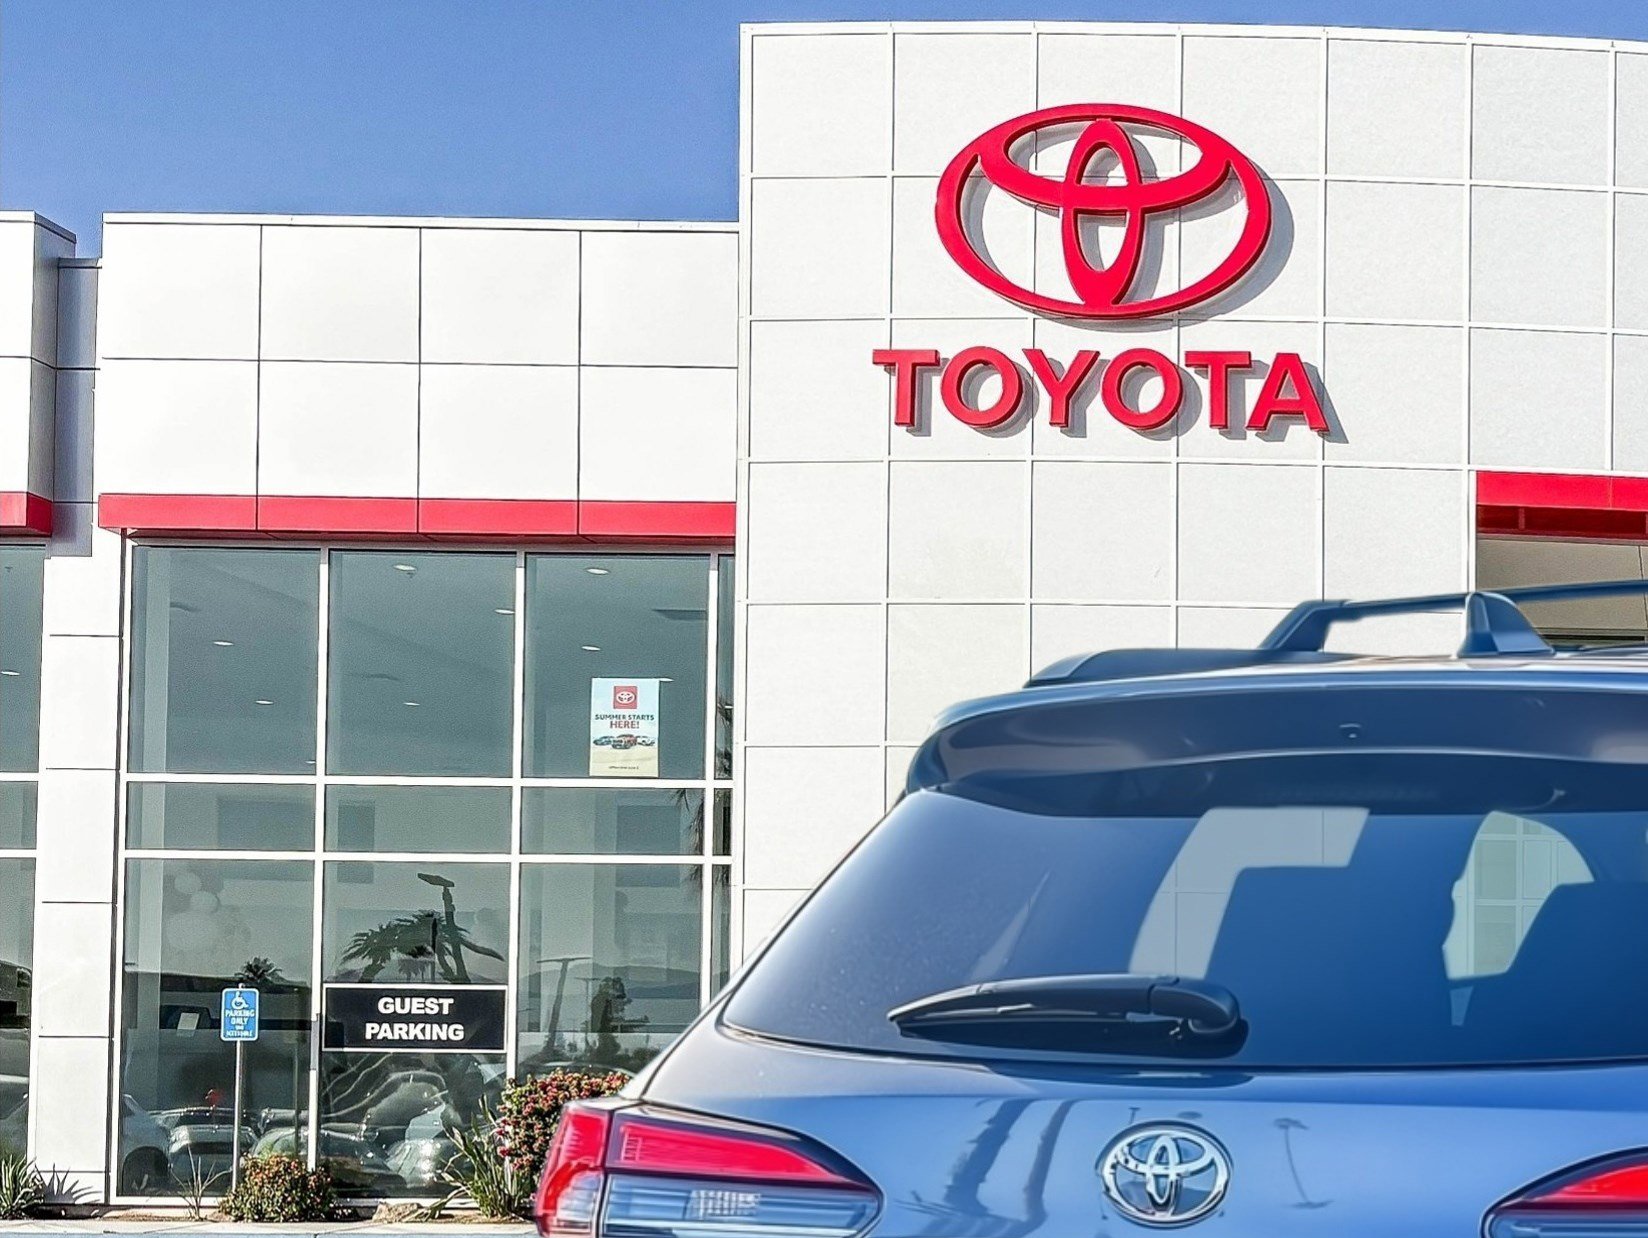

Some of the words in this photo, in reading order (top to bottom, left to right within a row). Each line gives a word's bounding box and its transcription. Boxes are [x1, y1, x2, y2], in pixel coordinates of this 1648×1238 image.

[872, 346, 1331, 434] TOYOTA
[609, 720, 640, 729] HERE!
[377, 997, 454, 1015] GUEST
[365, 1022, 465, 1041] PARKING
